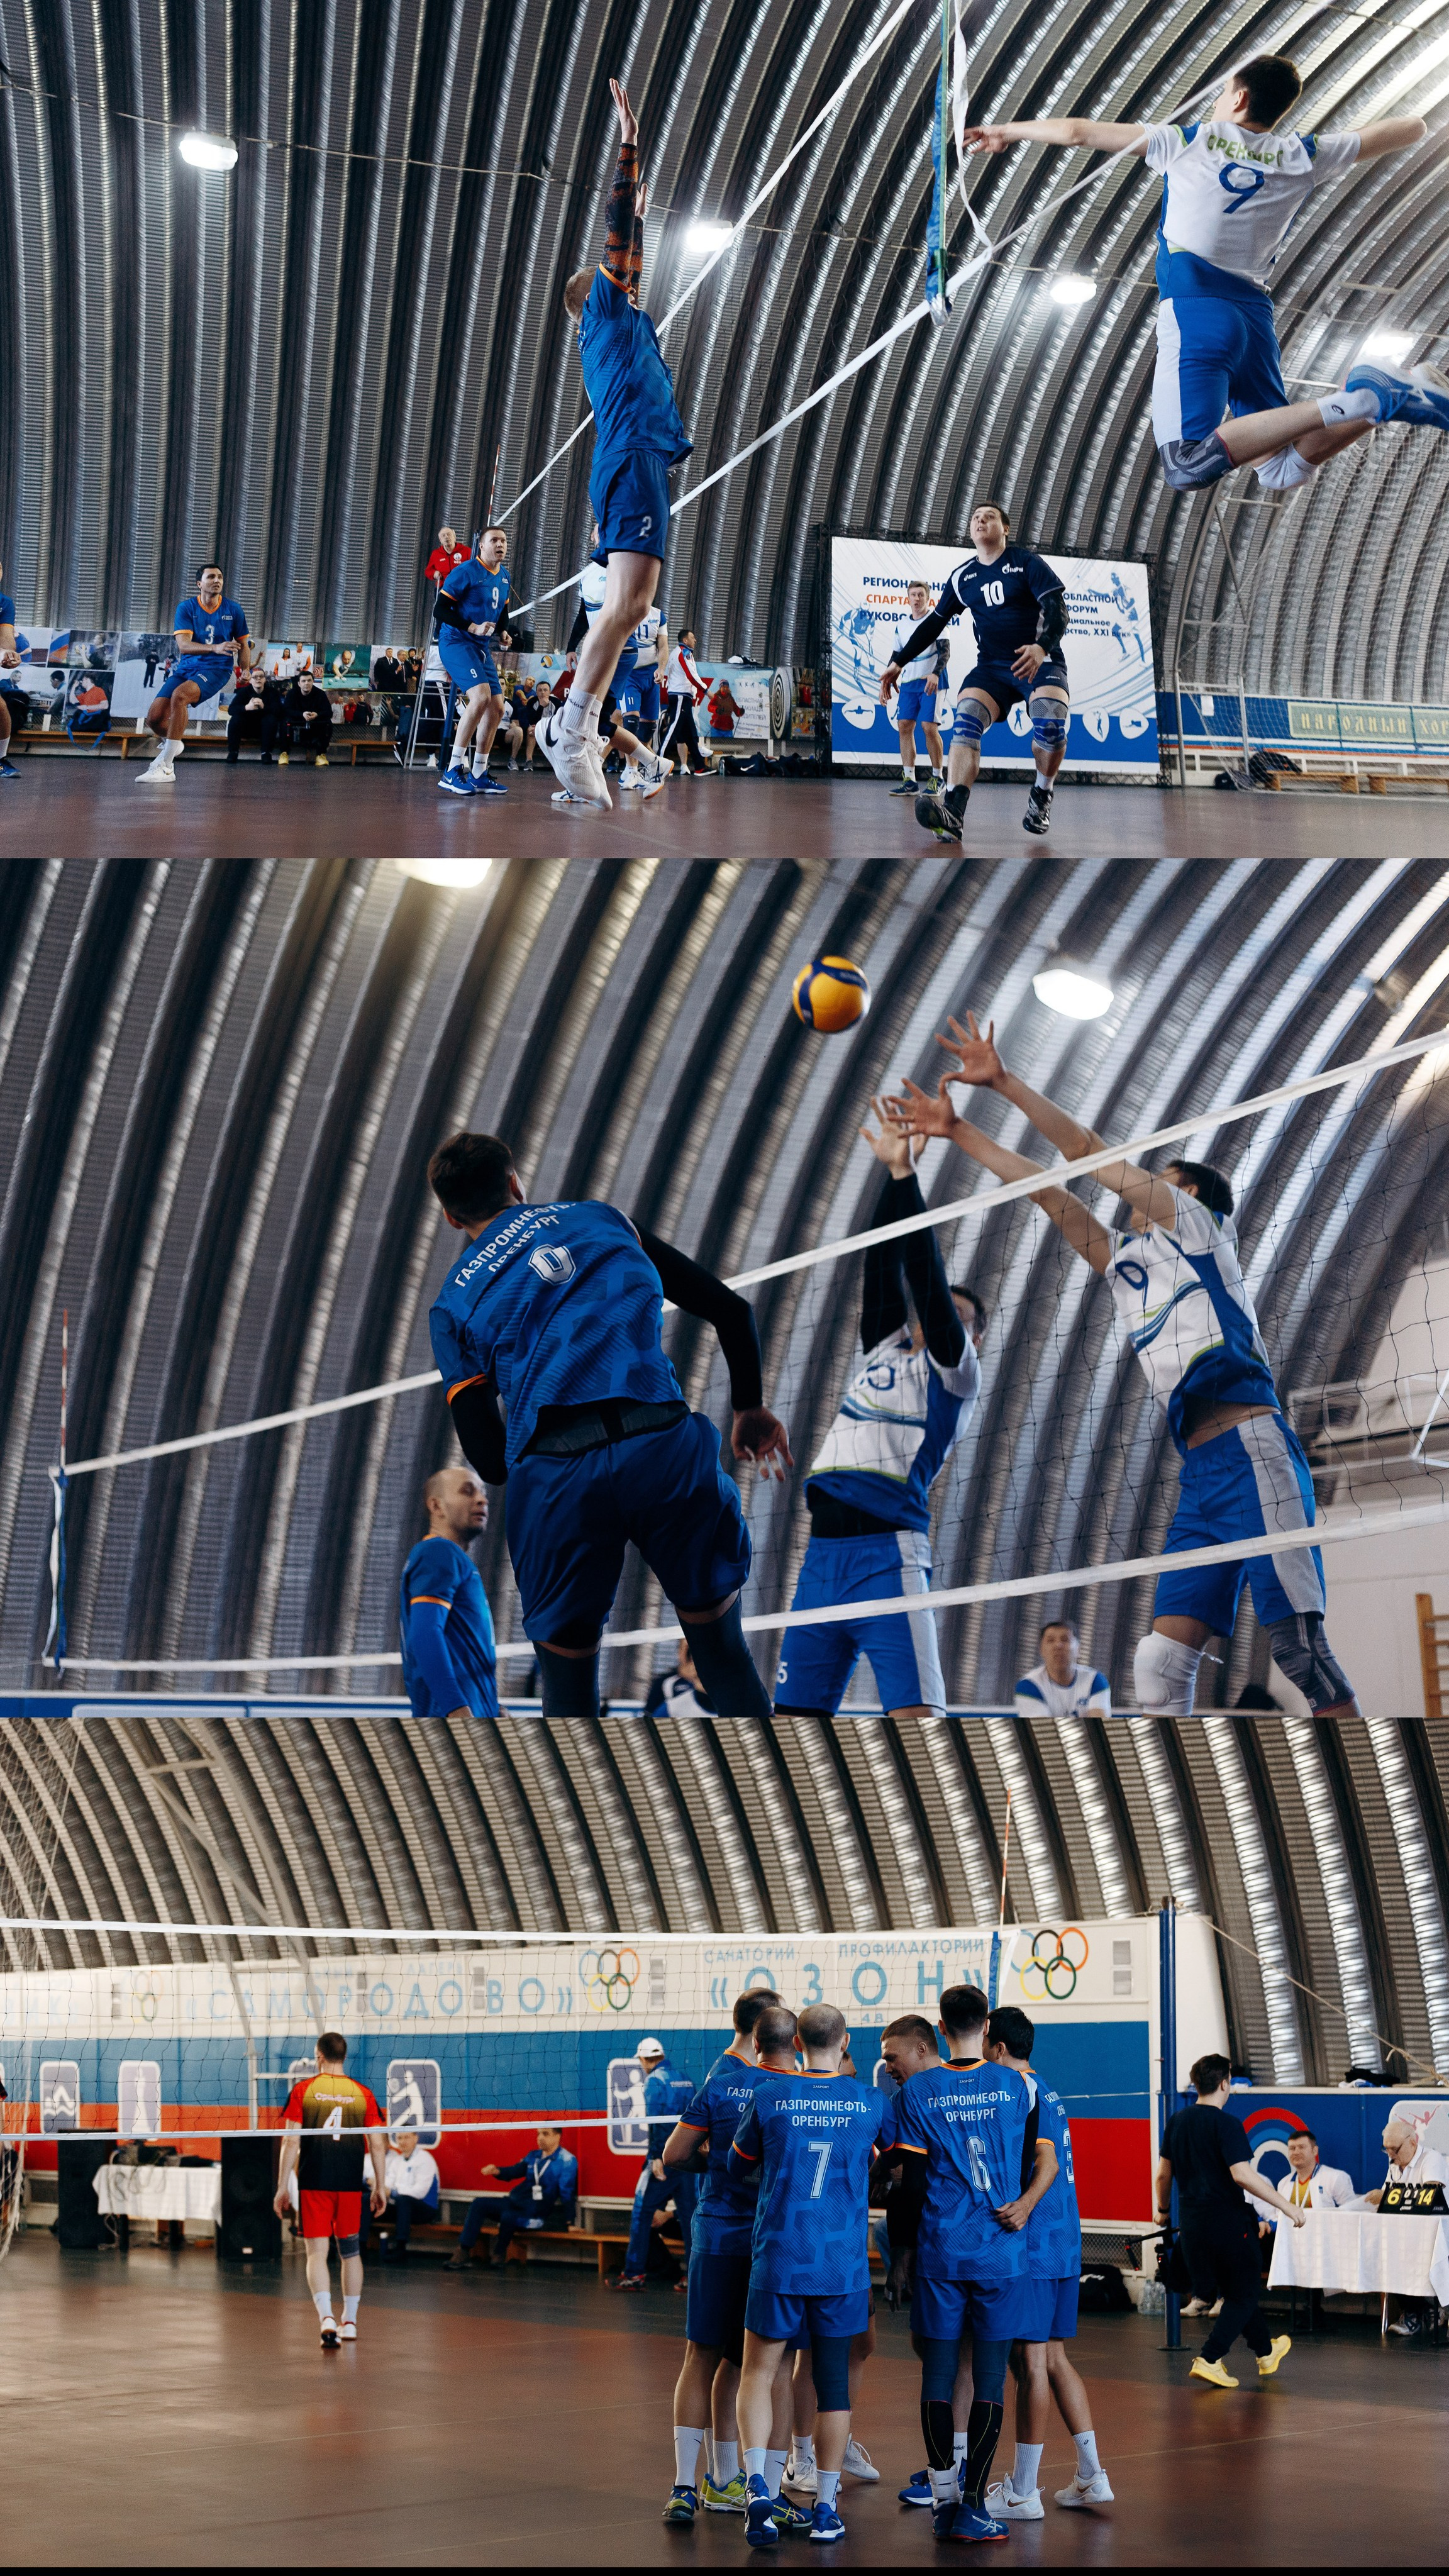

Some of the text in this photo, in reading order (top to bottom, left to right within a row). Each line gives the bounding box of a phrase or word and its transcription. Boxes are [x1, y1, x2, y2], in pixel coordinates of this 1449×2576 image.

[1219, 162, 1265, 214] 9
[639, 515, 652, 538] 2
[491, 586, 499, 609] 9
[980, 580, 1005, 607] 10
[1069, 618, 1111, 626] циальное
[205, 624, 214, 645] 3
[1064, 628, 1091, 636] рство,
[470, 668, 478, 679] 9
[628, 697, 634, 705] 11
[704, 1942, 795, 1963] САНАТОРИЙ
[775, 2099, 872, 2113] ГАЗПРОМНЕФТЬ-
[928, 2090, 1016, 2108] ГАЗПРОМНЕФТЬ-
[323, 2106, 343, 2141] 4
[792, 2115, 852, 2128] ОРЕНБУРГ
[946, 2107, 996, 2122] ОРЕНБУРГ
[808, 2141, 833, 2199] 7
[966, 2136, 992, 2192] 6
[1387, 2189, 1434, 2206] 6 0 1 14
